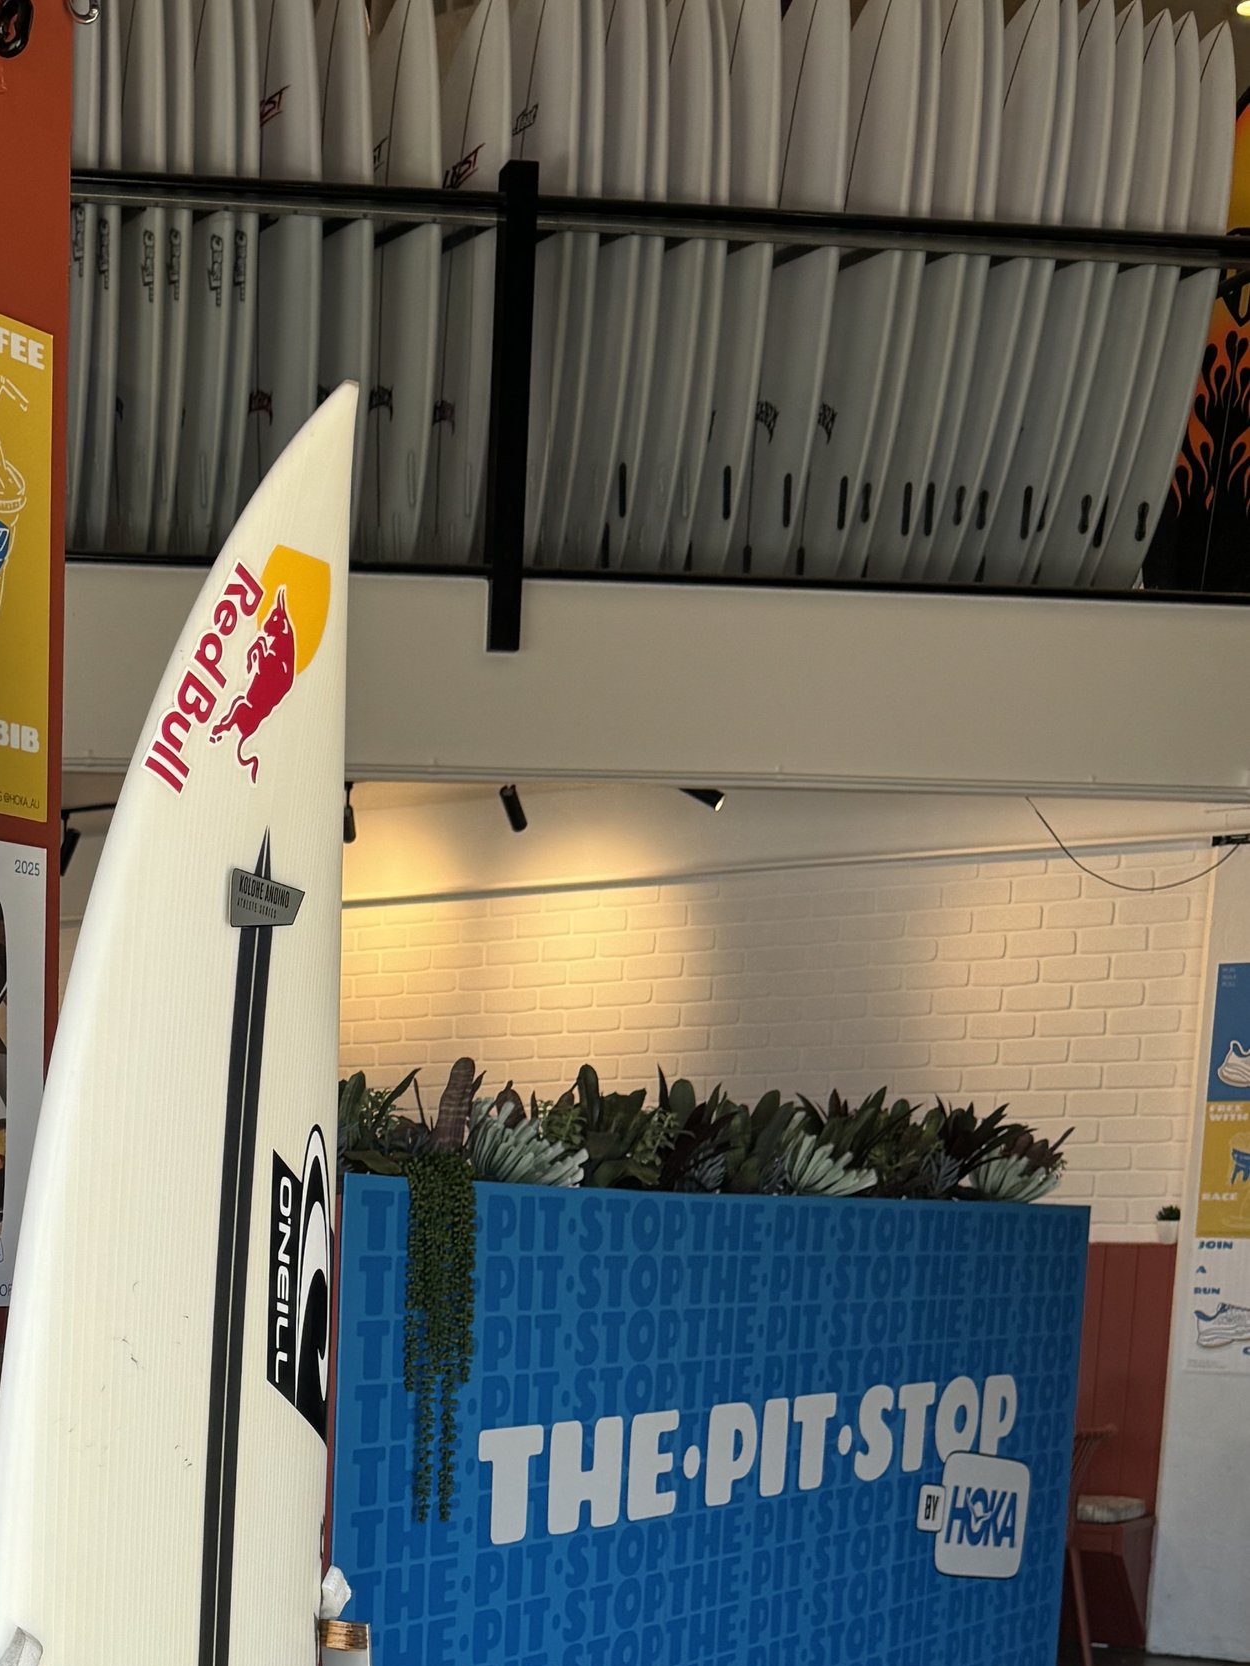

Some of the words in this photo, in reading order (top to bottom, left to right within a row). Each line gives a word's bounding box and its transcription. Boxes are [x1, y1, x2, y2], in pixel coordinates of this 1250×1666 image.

[196, 562, 264, 689] Red
[146, 670, 217, 794] Bull
[14, 859, 40, 876] 2025
[239, 874, 264, 900] KOLOHE
[265, 885, 290, 909] ANDINO
[1198, 1241, 1233, 1250] JOIN
[1196, 1266, 1206, 1274] A
[1194, 1287, 1221, 1295] RUN
[925, 1494, 939, 1521] BY
[944, 1483, 1017, 1549] HOKA
